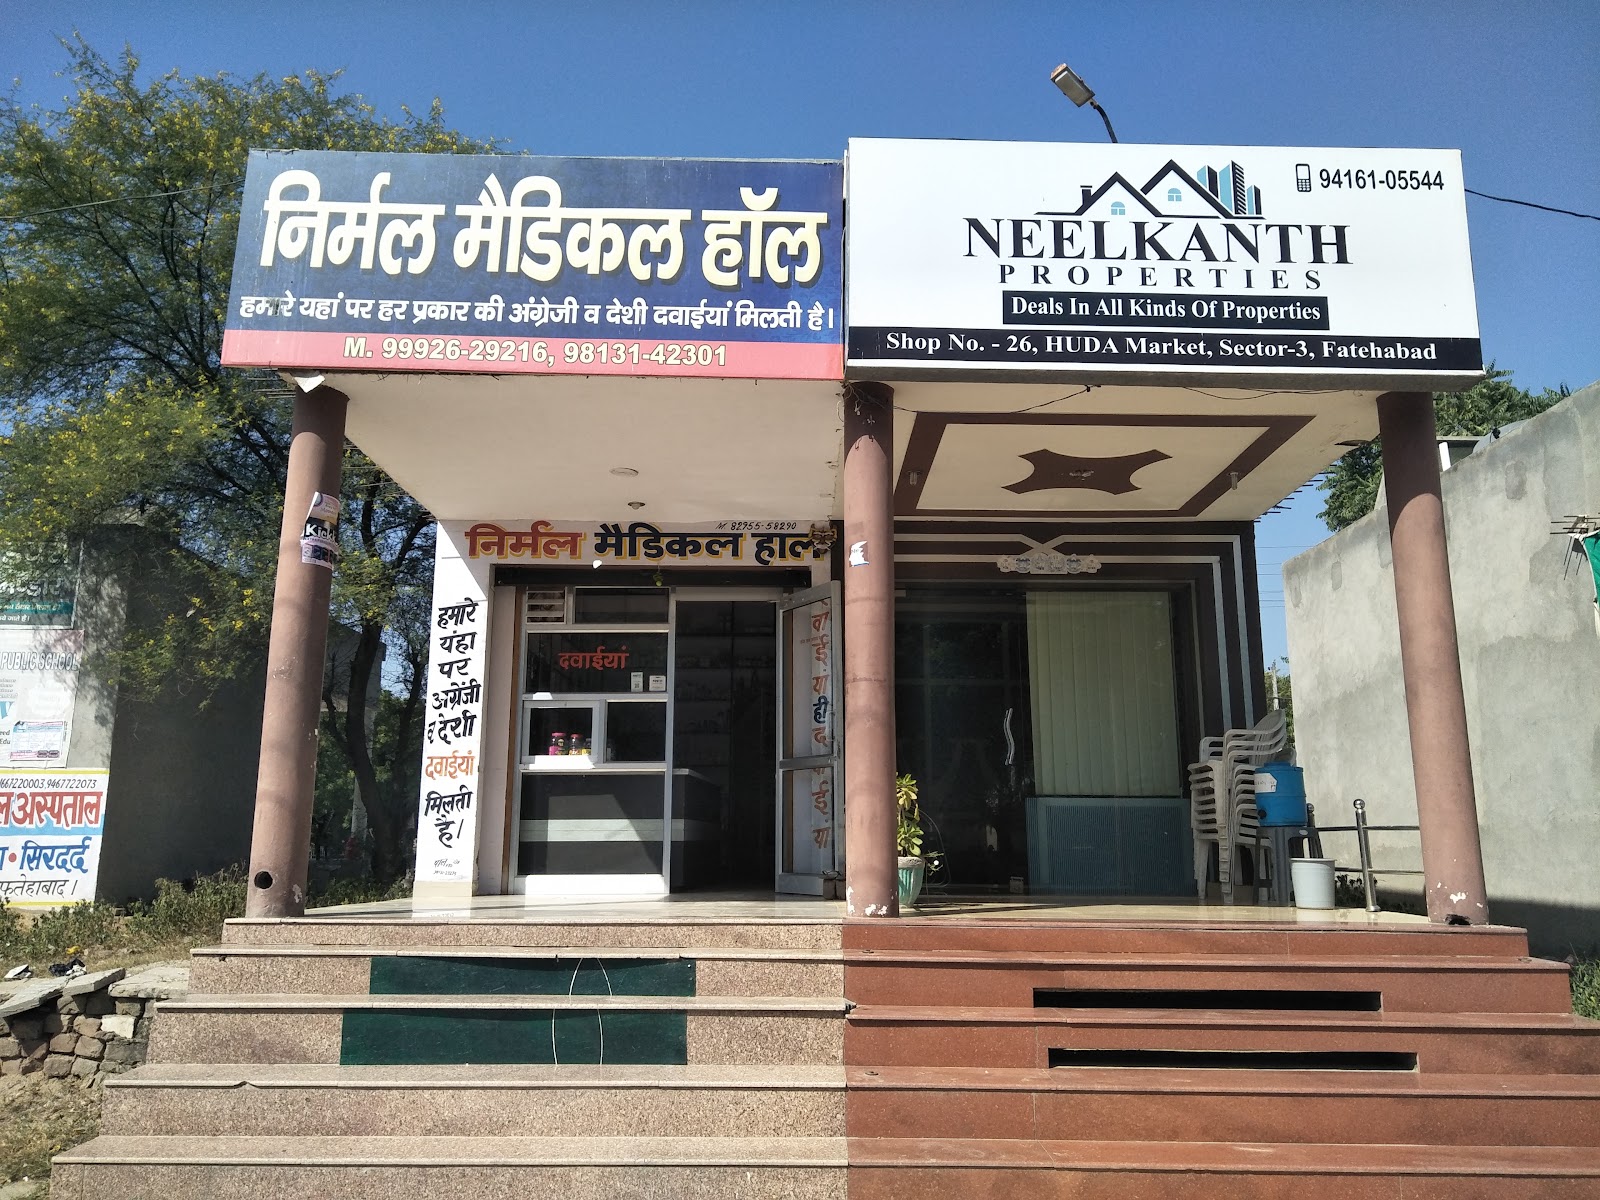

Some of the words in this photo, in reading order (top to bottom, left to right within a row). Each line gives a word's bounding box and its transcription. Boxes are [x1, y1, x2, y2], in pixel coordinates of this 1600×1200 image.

[1320, 169, 1444, 190] 94161-05544
[260, 169, 445, 274] निर्मल
[452, 172, 691, 282] मैडिकल
[702, 186, 827, 286] हॉल
[963, 216, 1353, 266] NEELKANTH
[999, 263, 1323, 291] PROPERTIES
[299, 292, 344, 320] यहां
[345, 299, 375, 319] पर
[378, 300, 406, 321] हर
[412, 300, 471, 324] प्रकार
[474, 294, 506, 322] की
[508, 296, 579, 327] अंग्रेजी
[584, 305, 601, 324] व
[605, 298, 648, 325] देशी
[653, 299, 734, 329] दवाईयां
[735, 300, 802, 328] मिलती
[1011, 296, 1063, 315] Deals
[1070, 298, 1090, 315] In
[1095, 299, 1123, 316] All
[1129, 299, 1186, 317] Kinds
[1191, 300, 1218, 318] Of
[1222, 301, 1321, 323] Properties
[343, 336, 373, 358] M.
[381, 337, 555, 367] 99926-29216,
[564, 342, 727, 366] 98131-42301
[886, 332, 941, 354] Shop
[948, 334, 985, 352] No.
[1006, 335, 1038, 355] 26,
[1045, 336, 1120, 354] HUDA
[1125, 338, 1213, 358] Market,
[1219, 339, 1315, 360] Sector-3,
[1322, 341, 1437, 360] Fatehabad
[730, 521, 797, 531] 82955-58290
[465, 520, 585, 558] निर्मल
[594, 522, 744, 559] मैडिकल
[751, 532, 825, 566] हाल
[437, 597, 479, 630] हमारे
[1, 652, 38, 670] PUBLIC
[37, 652, 79, 671] SCHOOL
[438, 657, 471, 679] पर
[558, 645, 629, 671] दवाईयां
[437, 709, 478, 746] देशी
[425, 750, 476, 781] दवाईयां
[11, 791, 103, 828] अस्पताल
[424, 784, 474, 816] मिलती
[20, 836, 92, 874] सिरदर्द
